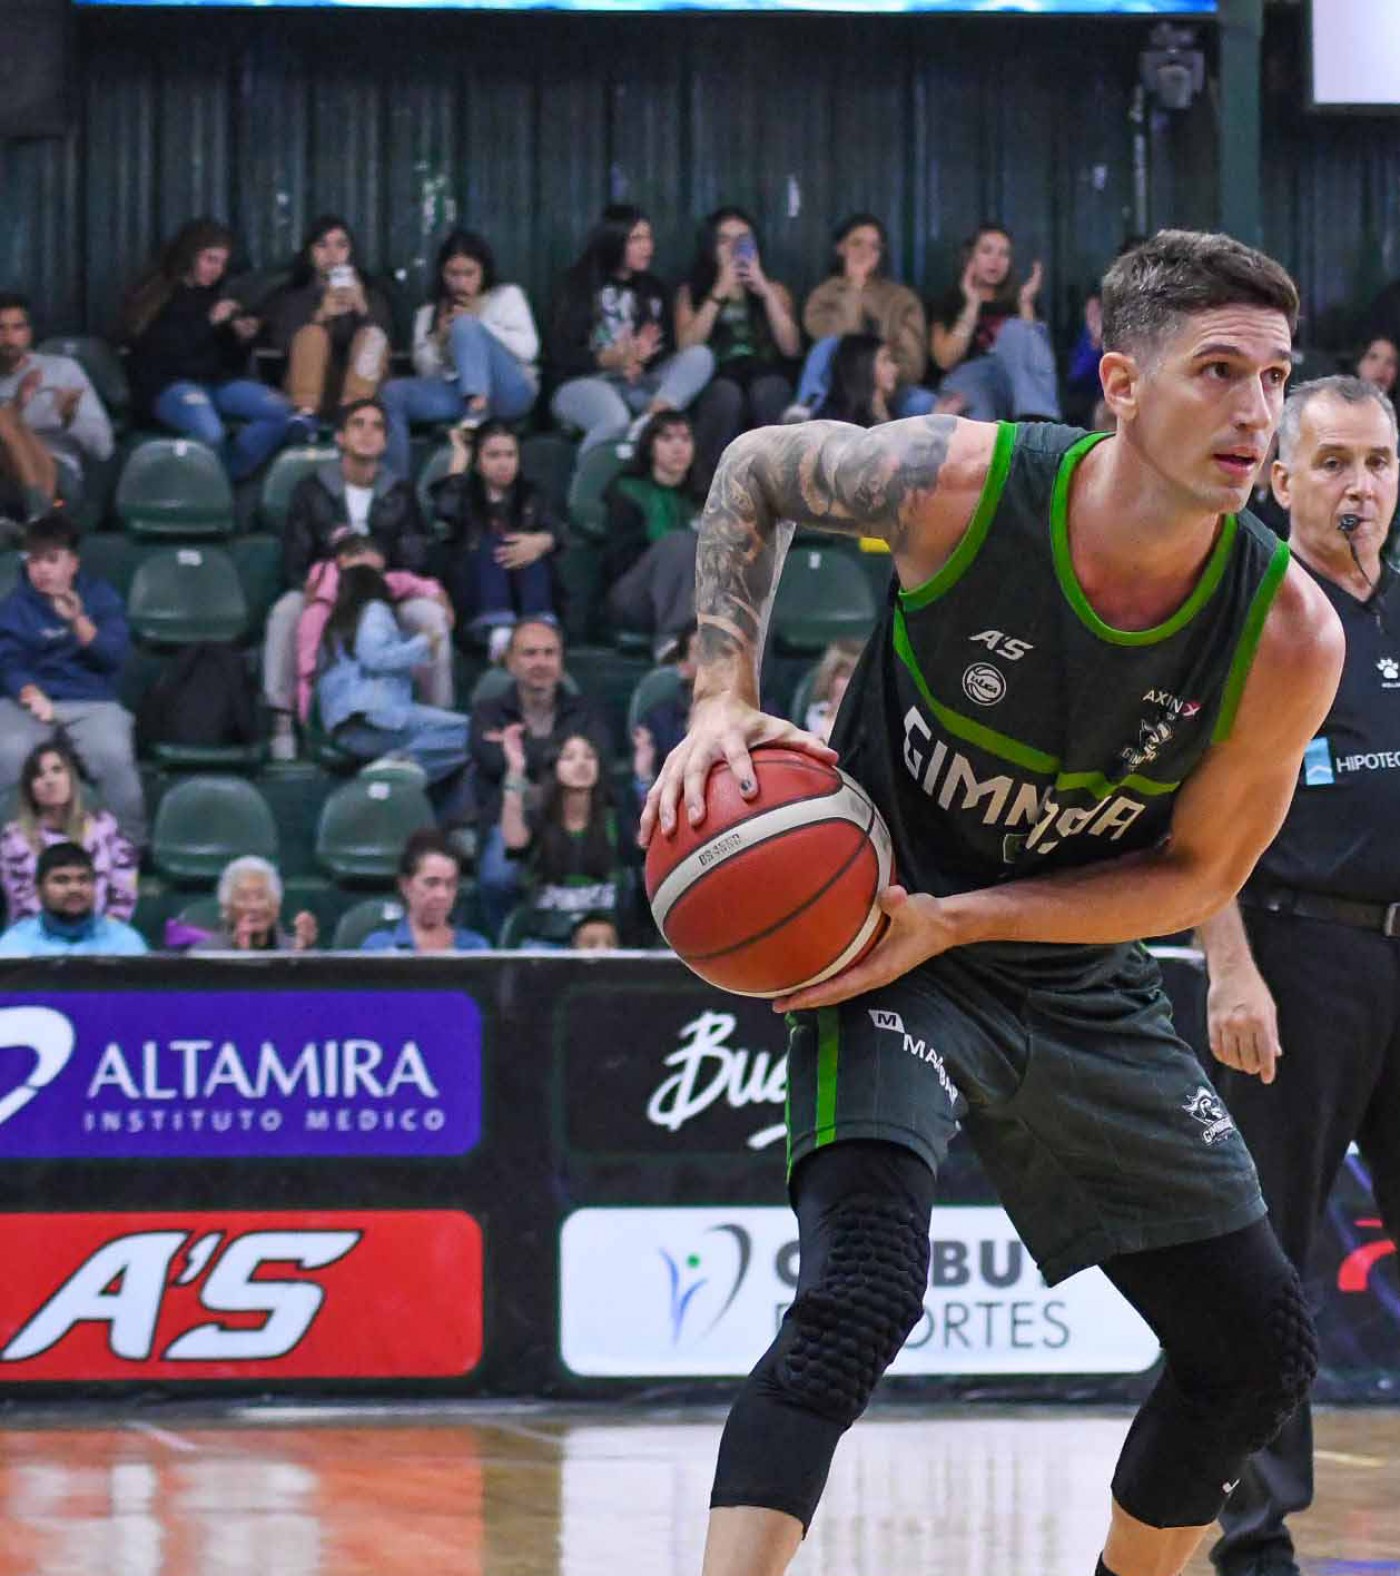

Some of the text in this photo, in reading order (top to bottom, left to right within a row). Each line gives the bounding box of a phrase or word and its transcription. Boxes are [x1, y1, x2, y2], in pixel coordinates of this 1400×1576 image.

[969, 630, 1034, 660] A'S
[877, 1013, 897, 1027] M
[86, 1040, 440, 1100] ALTAMIRA
[84, 1108, 446, 1132] INSTITUTO MEDICO
[2, 1229, 364, 1361] A'S
